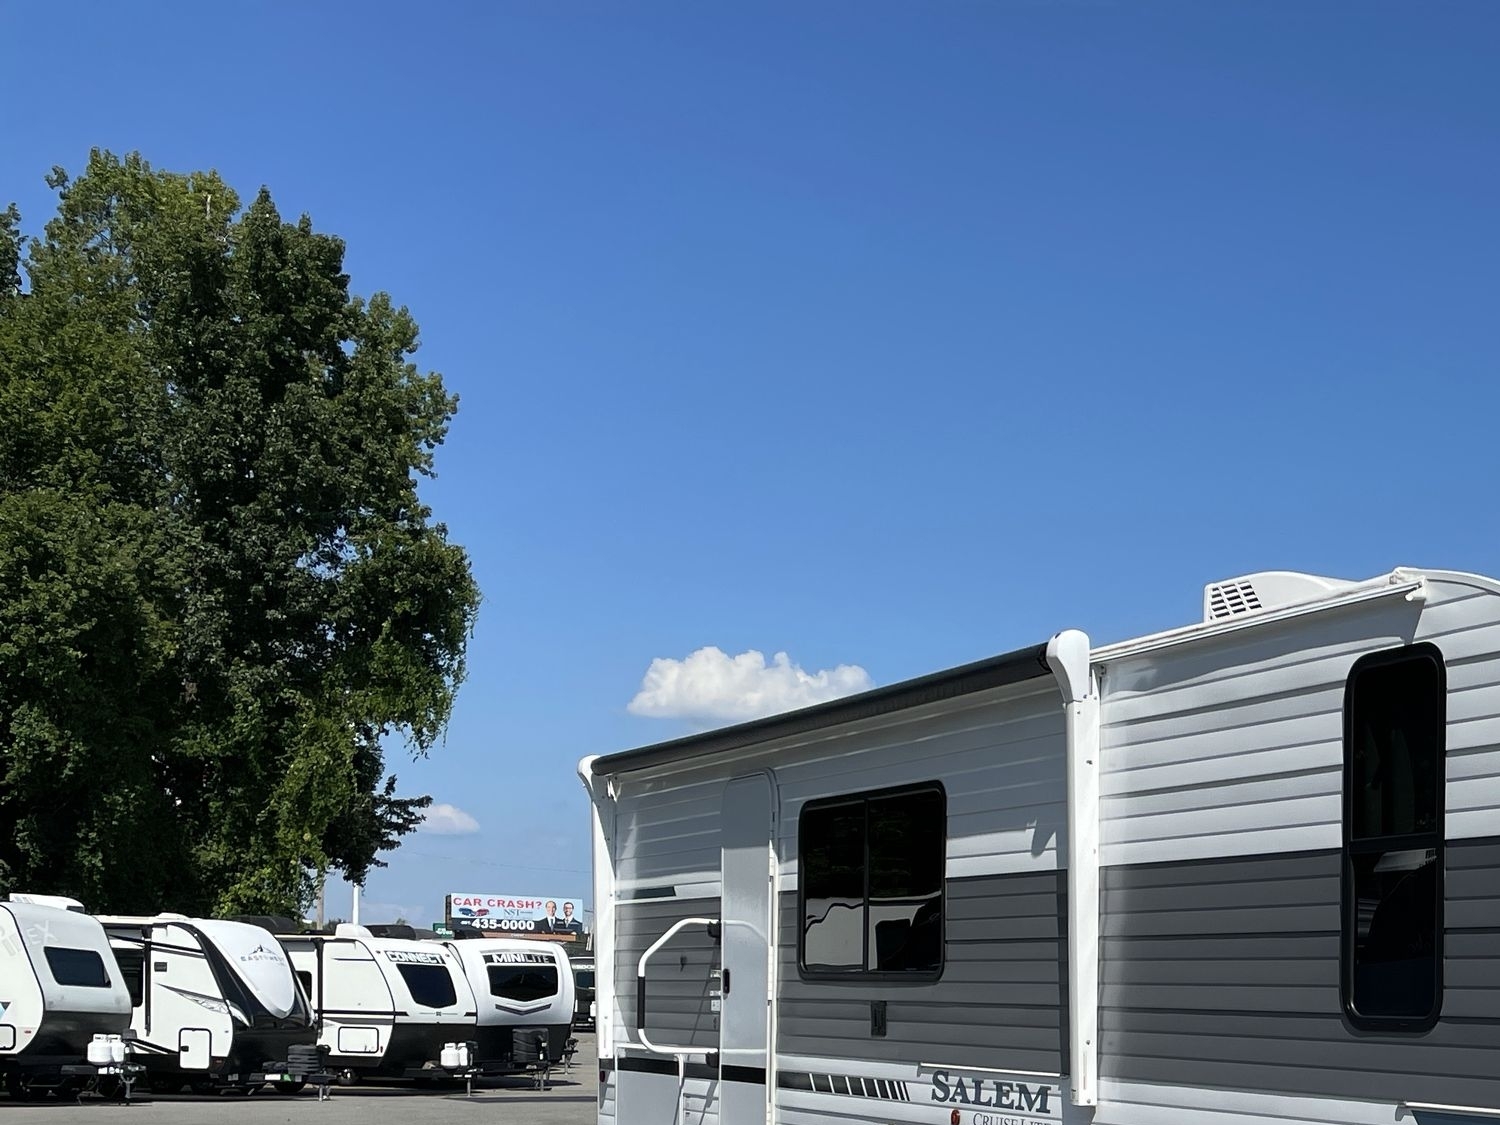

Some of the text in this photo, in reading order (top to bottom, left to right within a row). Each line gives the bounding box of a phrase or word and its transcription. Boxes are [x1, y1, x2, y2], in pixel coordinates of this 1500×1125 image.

[453, 897, 543, 909] CAR CRASH?
[471, 918, 535, 930] 435-0000
[386, 951, 443, 964] CONNECT
[931, 1070, 1051, 1114] SALEM
